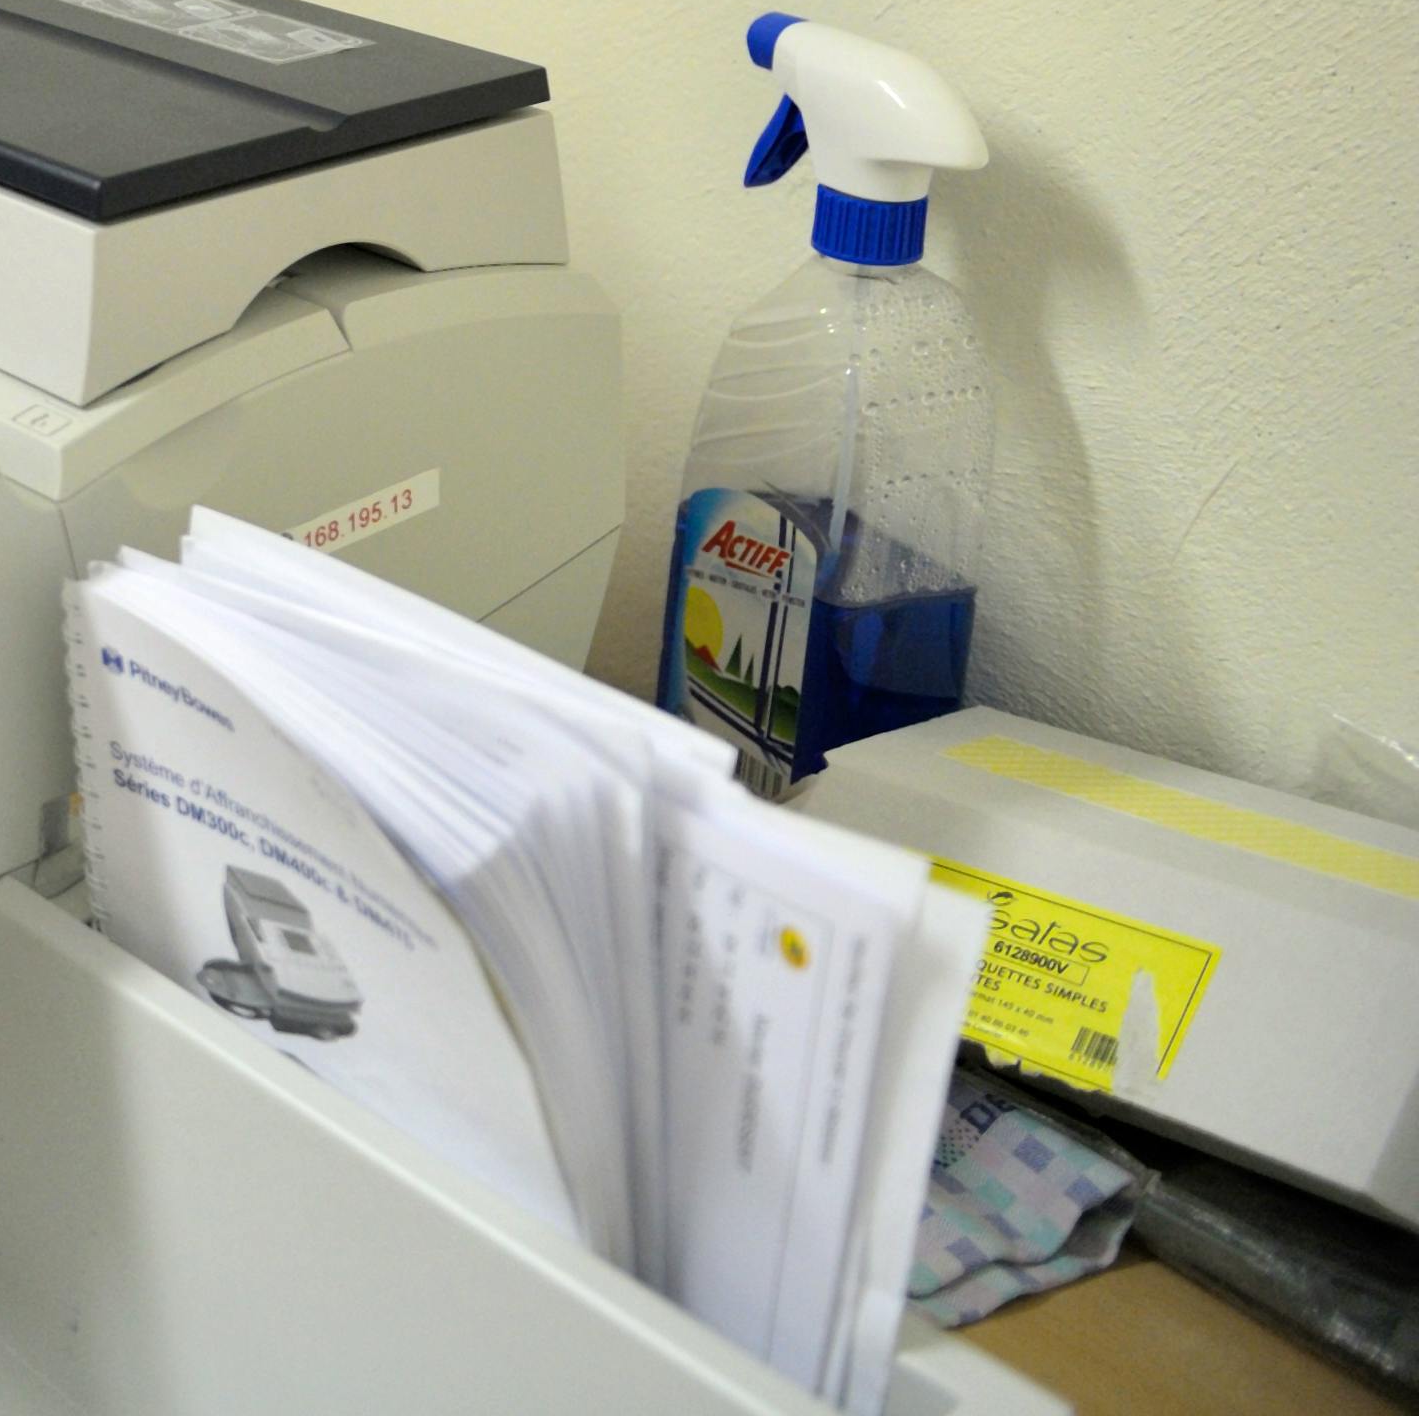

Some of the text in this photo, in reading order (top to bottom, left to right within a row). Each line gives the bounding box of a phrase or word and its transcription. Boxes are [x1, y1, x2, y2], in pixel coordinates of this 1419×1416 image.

[701, 519, 791, 574] ACTIFF
[110, 741, 185, 789] Système
[114, 768, 171, 808] Séries
[993, 940, 1070, 974] 6128900V
[975, 959, 1108, 1014] QUETTES SIMPLES
